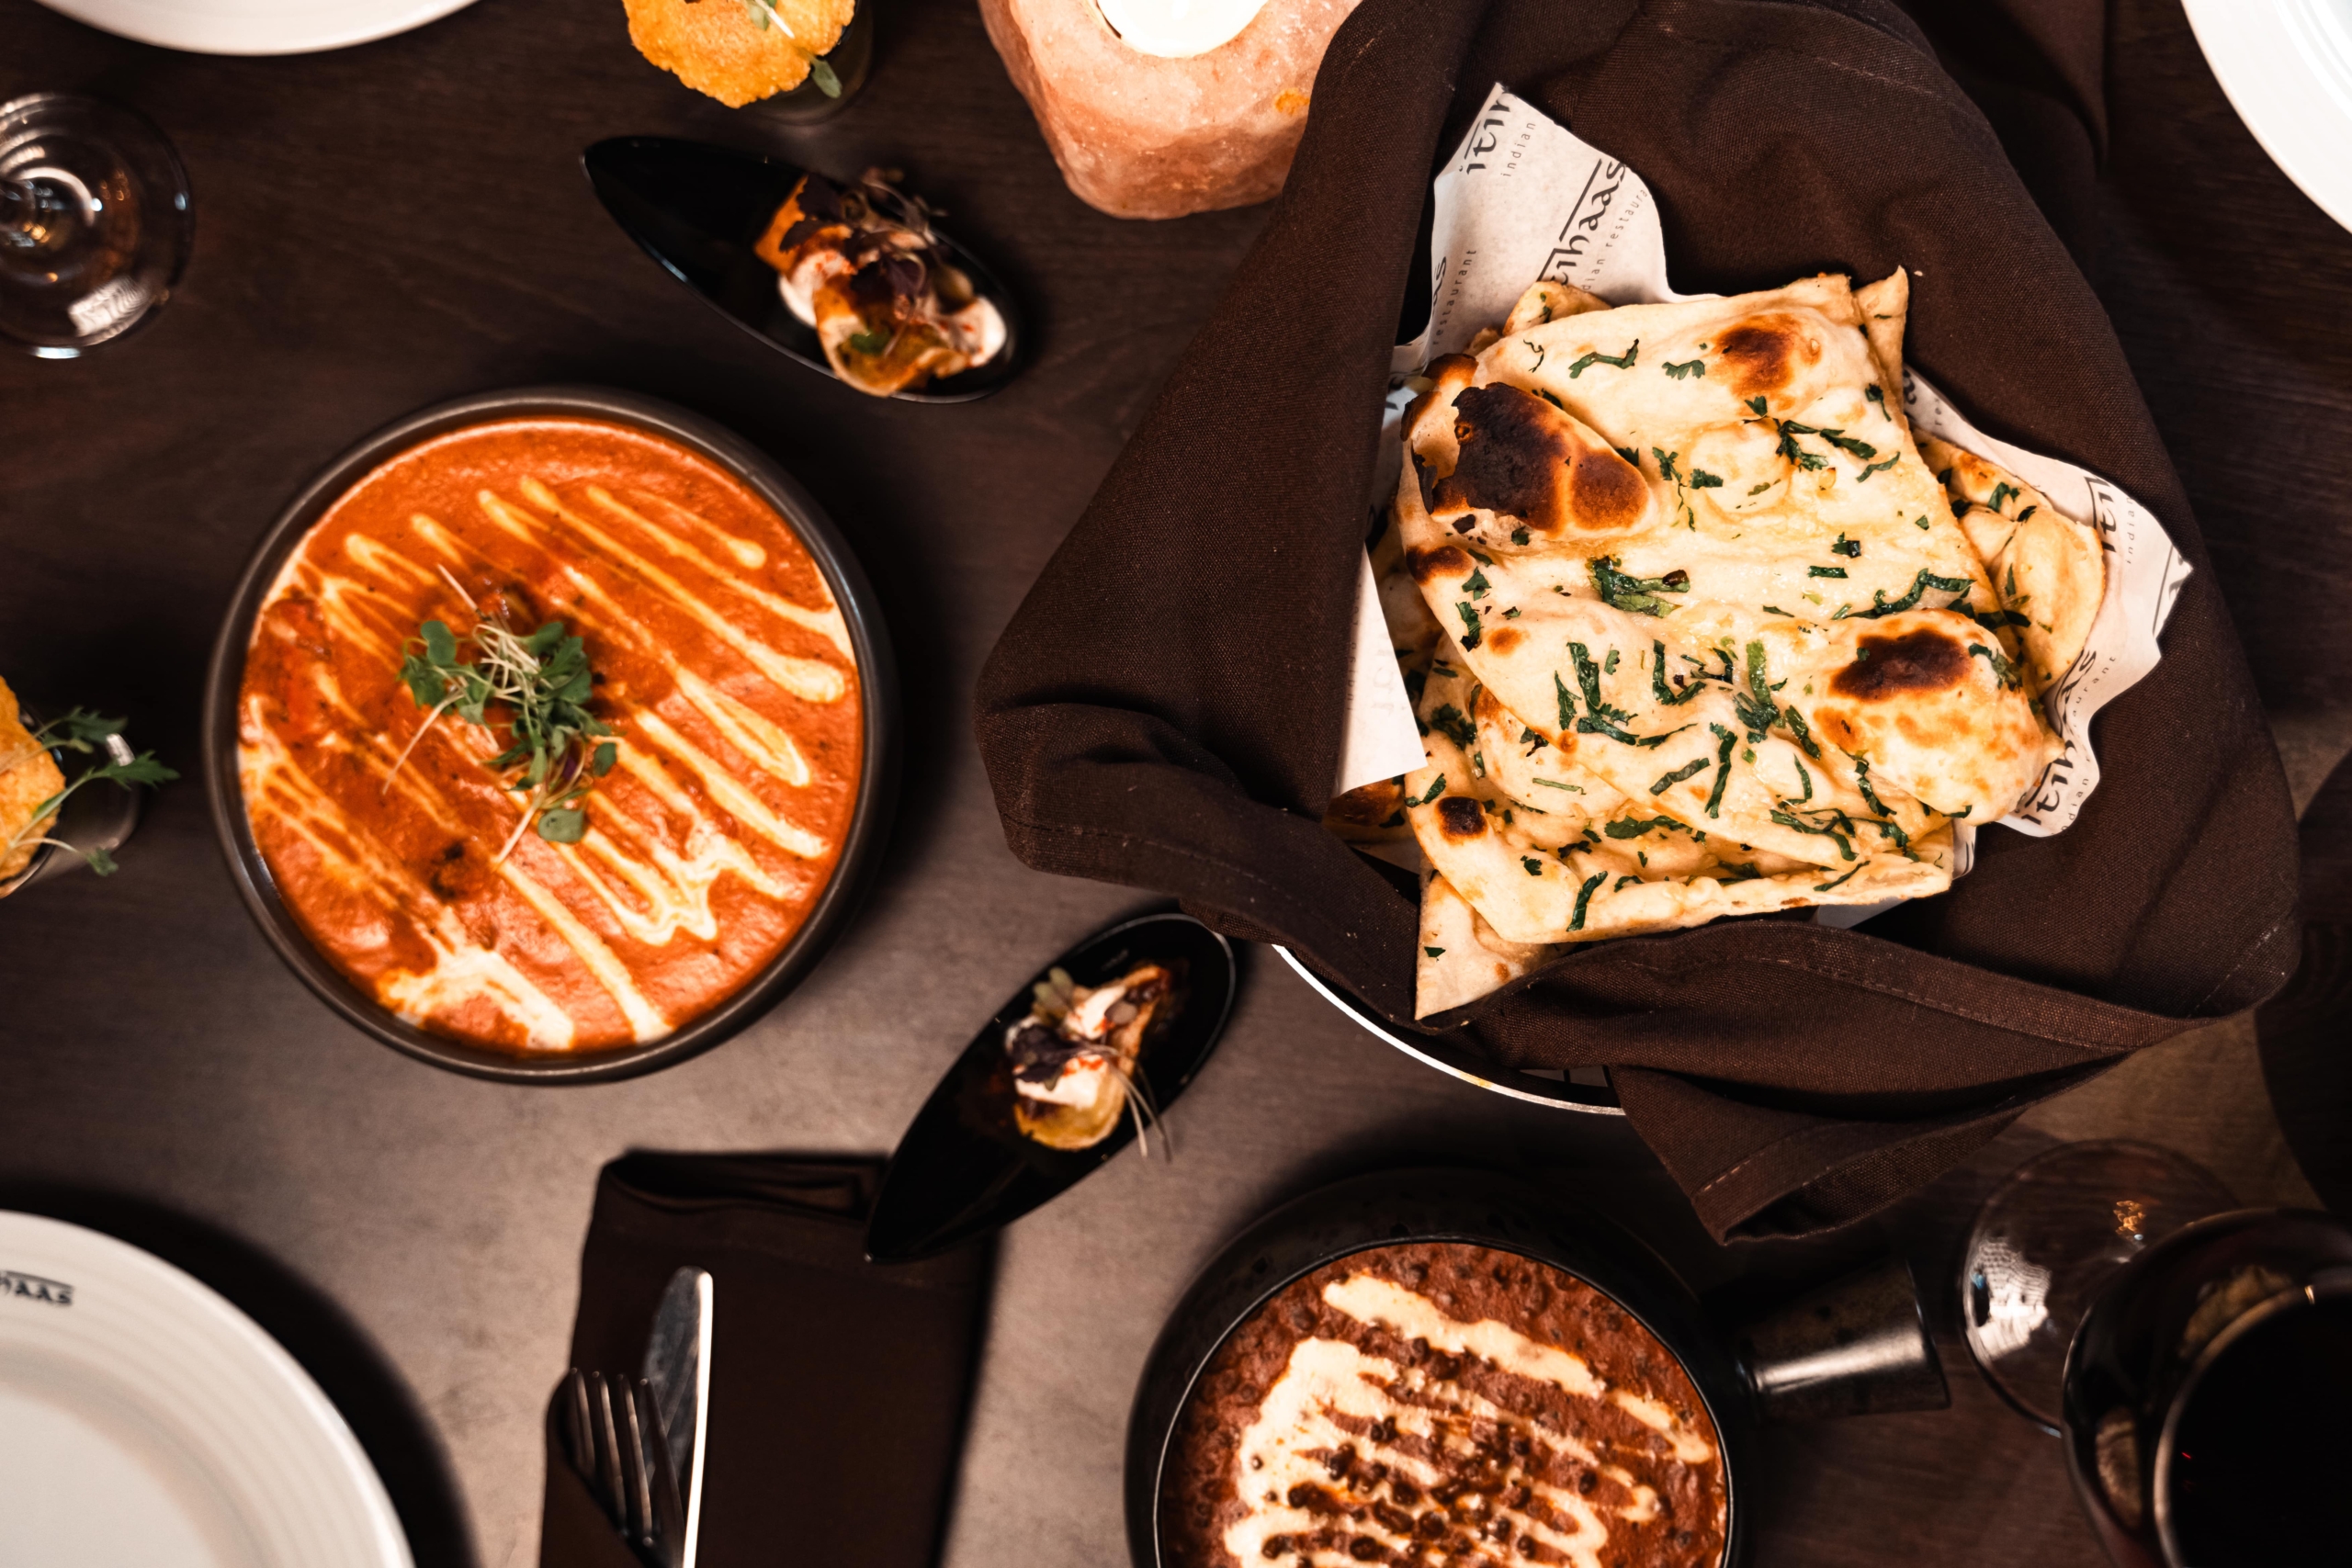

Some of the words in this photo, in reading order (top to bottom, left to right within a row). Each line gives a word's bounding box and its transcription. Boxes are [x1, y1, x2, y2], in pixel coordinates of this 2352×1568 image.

[1500, 121, 1537, 177] indian
[1432, 249, 1476, 345] restaurant
[2050, 778, 2090, 835] ndian
